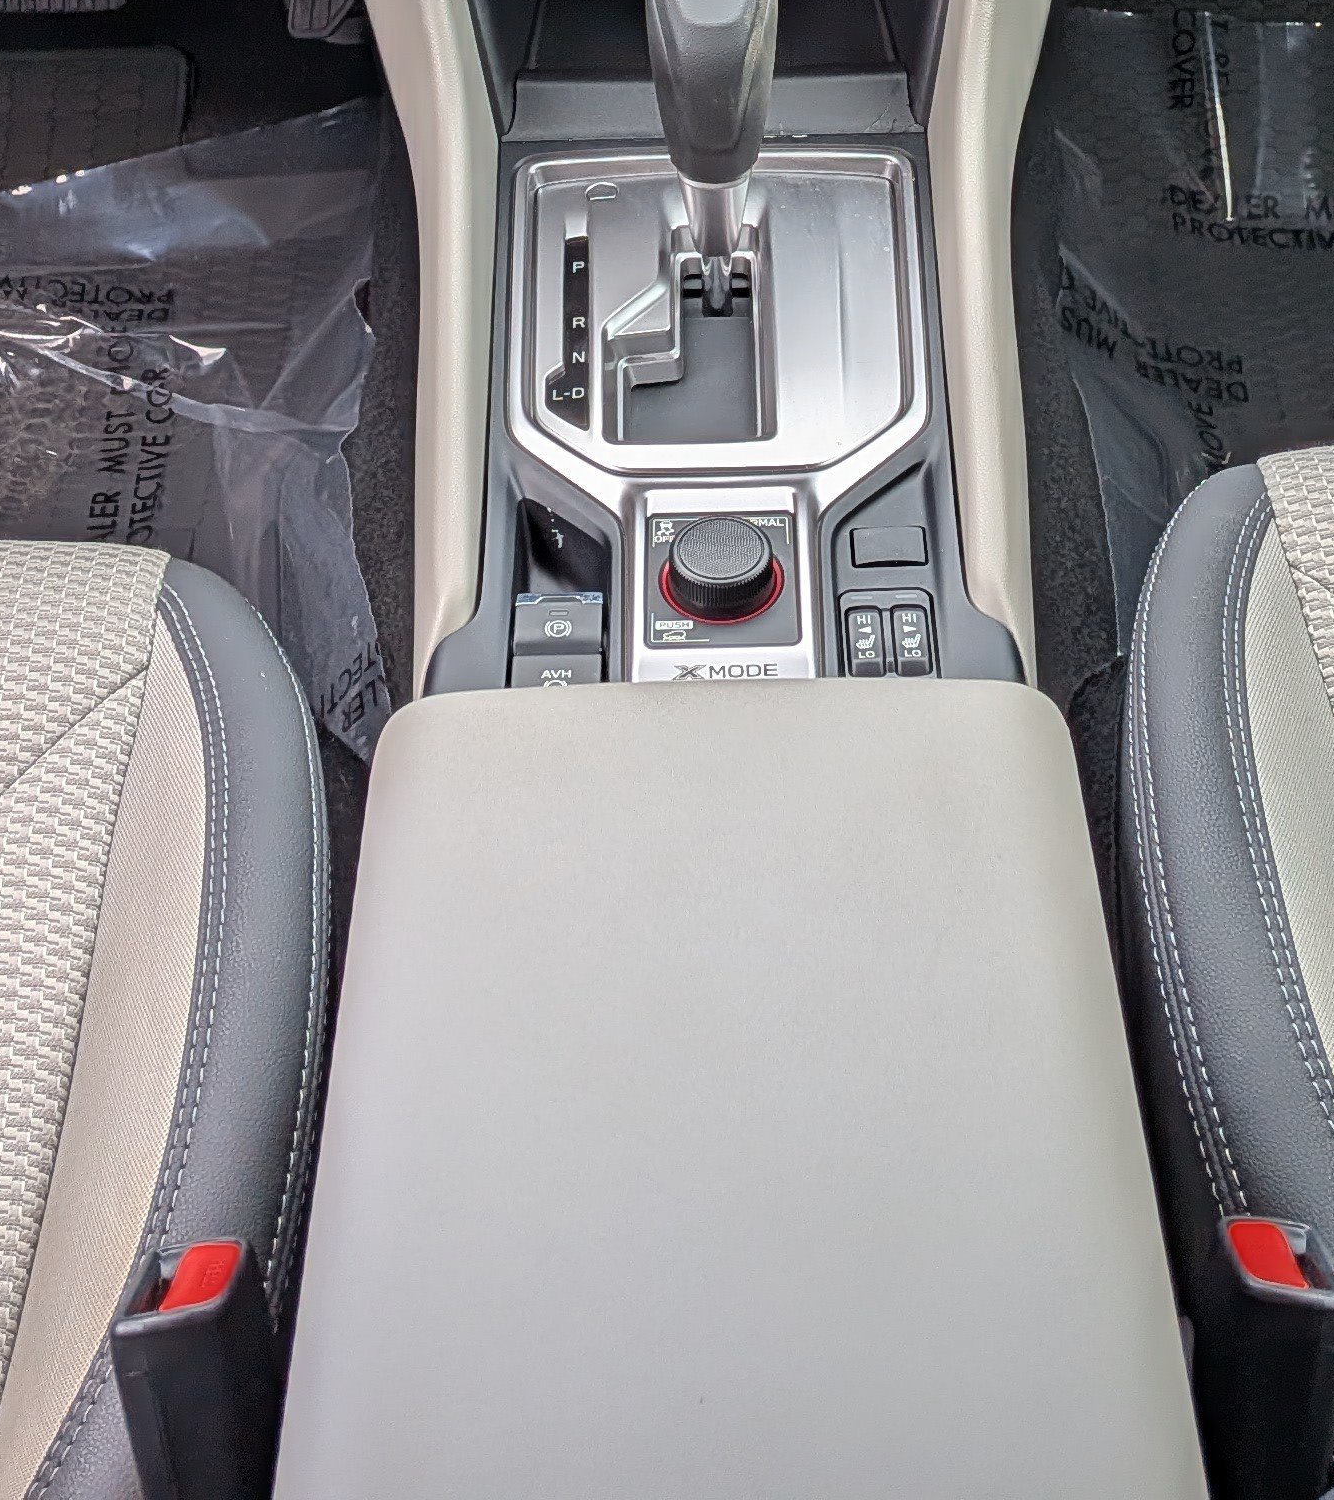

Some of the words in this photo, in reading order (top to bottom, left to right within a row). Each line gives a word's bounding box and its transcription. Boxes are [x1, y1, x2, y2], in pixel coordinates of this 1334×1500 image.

[572, 262, 585, 274] P
[572, 317, 585, 329] R
[572, 351, 585, 364] N
[1133, 358, 1250, 405] DEALER
[97, 410, 137, 476] MUST
[125, 432, 175, 546] OTECTIVE
[856, 615, 871, 625] HI
[902, 613, 917, 623] HI
[658, 621, 691, 629] PUSH
[858, 650, 875, 659] LO
[904, 649, 922, 657] LO
[541, 670, 572, 679] AVH
